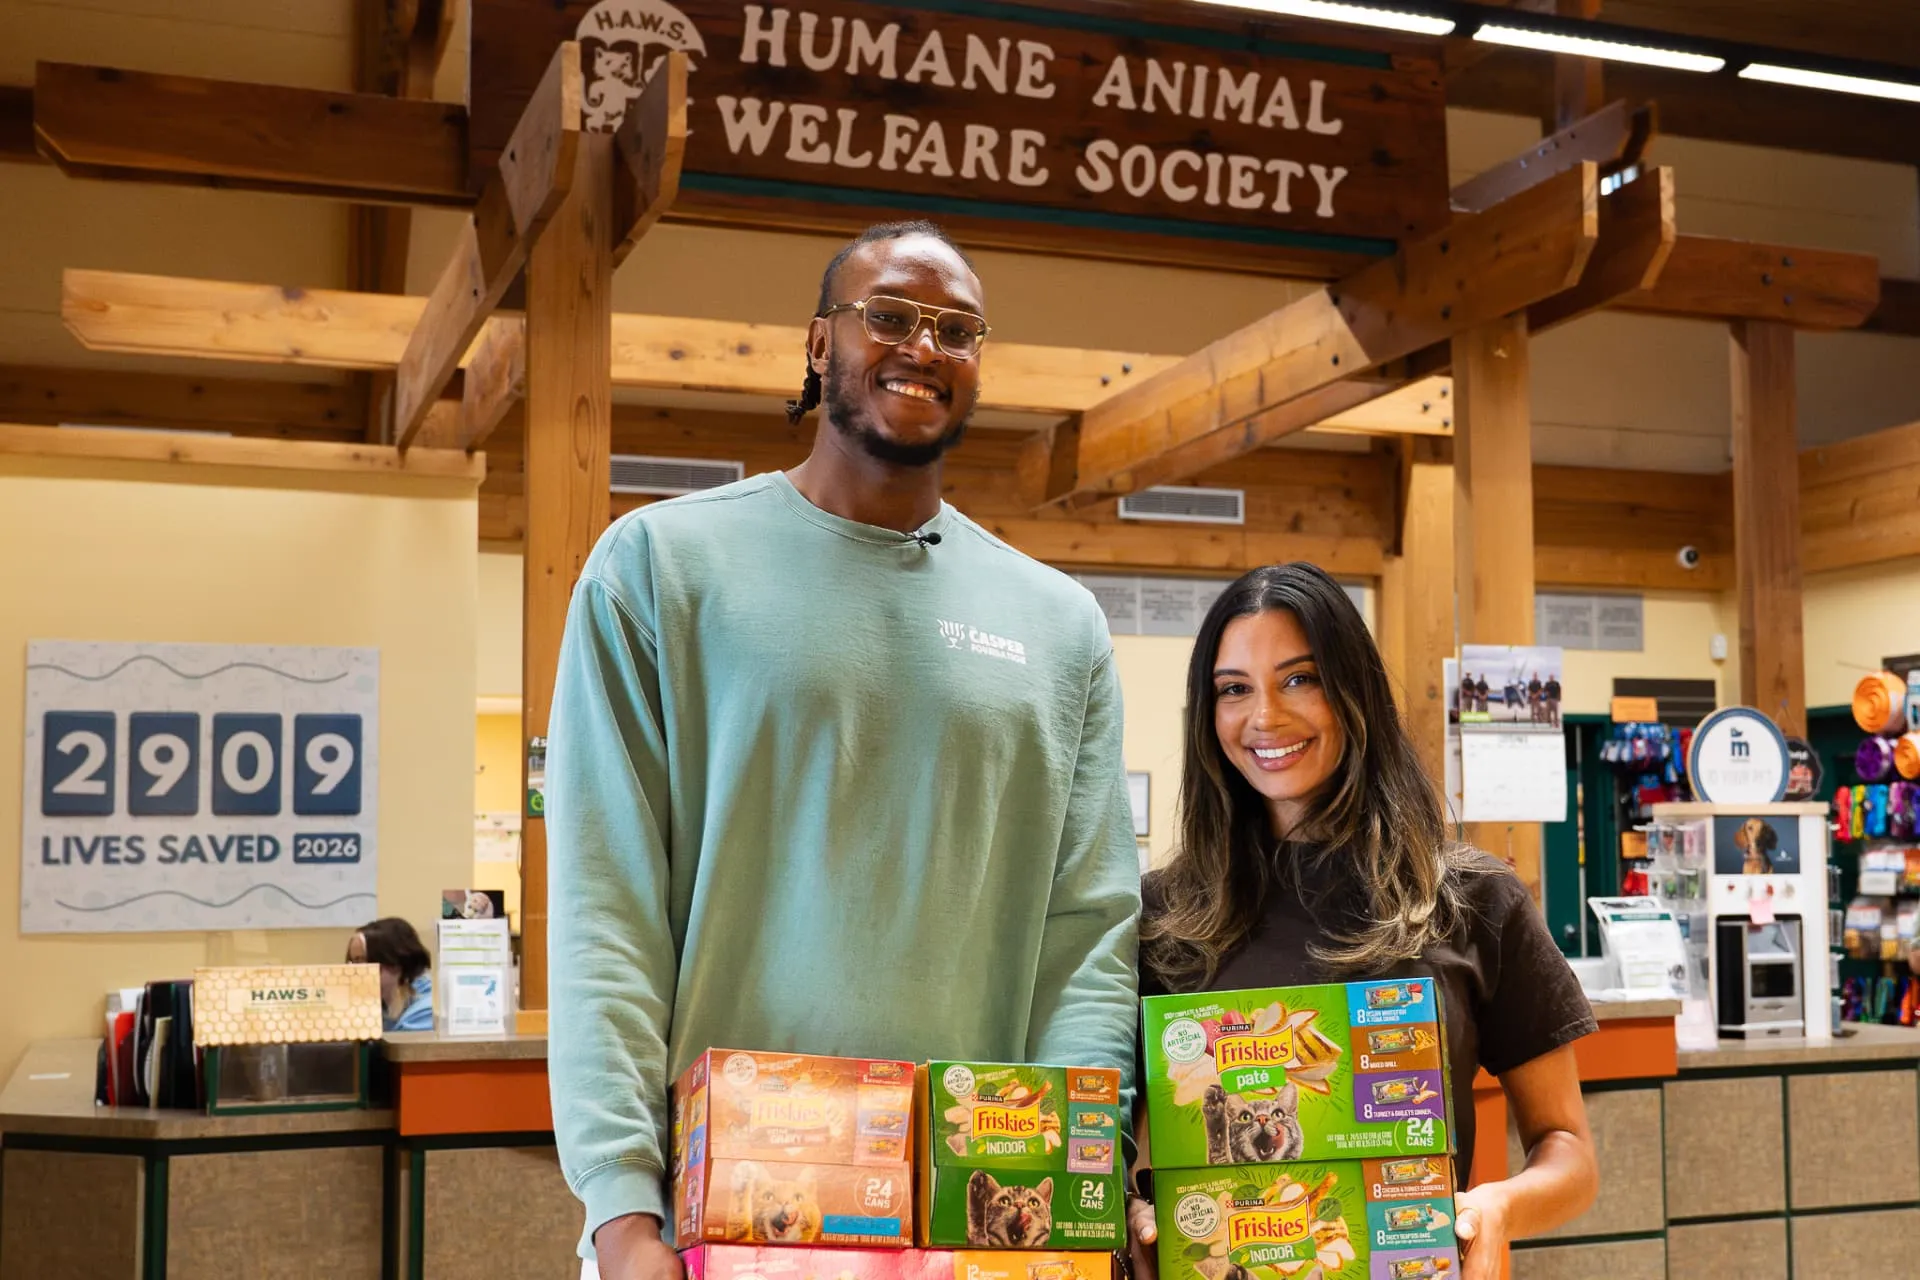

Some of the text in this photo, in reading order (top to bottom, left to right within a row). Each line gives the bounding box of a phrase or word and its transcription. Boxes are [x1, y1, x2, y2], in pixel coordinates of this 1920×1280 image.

[594, 10, 688, 46] H.A.W.S.
[740, 5, 1342, 135] HUMANE ANIMAL
[716, 95, 1347, 218] WELFARE SOCIETY
[51, 730, 355, 797] 2909
[41, 834, 359, 865] LIVES SAVED 2026
[251, 988, 308, 1001] HAWS
[1357, 1009, 1366, 1023] 8
[1221, 1041, 1289, 1065] Friskies
[1360, 1055, 1369, 1069] 8
[1236, 1071, 1270, 1090] paté
[758, 1101, 821, 1121] Friskies
[1364, 1104, 1373, 1119] 8
[978, 1111, 1035, 1132] Friskies
[1406, 1117, 1434, 1137] 24
[986, 1140, 1026, 1155] INDOOR
[1406, 1137, 1434, 1147] CANS
[866, 1178, 892, 1199] 24
[1081, 1180, 1104, 1200] 24
[1373, 1184, 1382, 1198] 8
[865, 1197, 890, 1209] CANS
[1080, 1199, 1104, 1210] CANS
[1191, 1203, 1201, 1212] NO
[1180, 1207, 1214, 1223] ARTIFICIAL
[1234, 1216, 1304, 1241] Friskies
[1376, 1230, 1386, 1245] 8
[1251, 1245, 1294, 1263] INDOOR
[967, 1264, 980, 1280] 12
